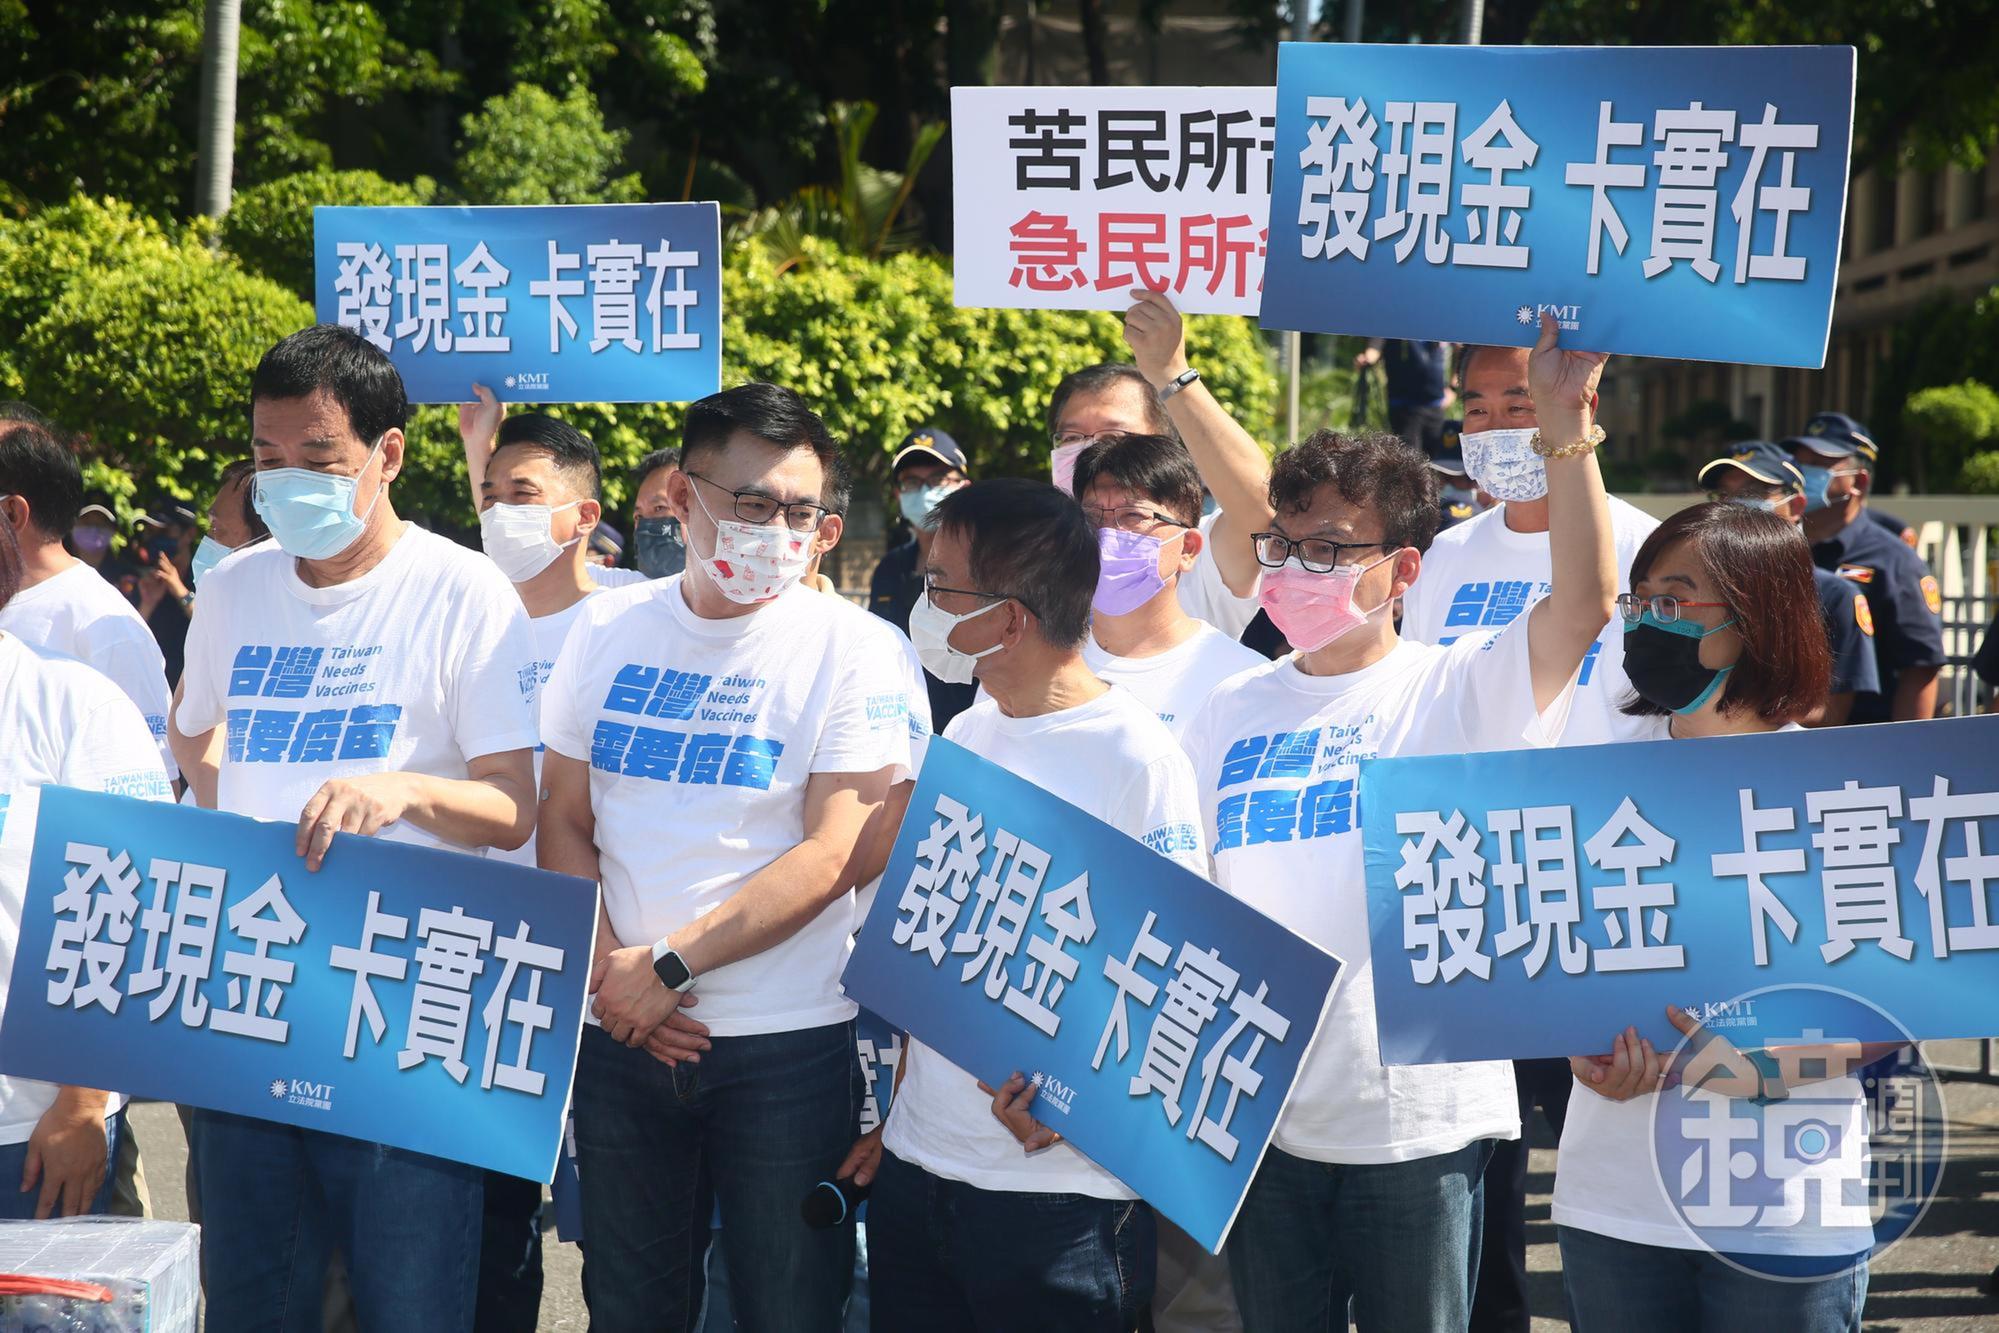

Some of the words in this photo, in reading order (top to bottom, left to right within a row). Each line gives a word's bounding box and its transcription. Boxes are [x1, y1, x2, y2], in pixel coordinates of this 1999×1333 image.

[1298, 96, 1539, 269] 發現金
[1565, 101, 1819, 284] 卡實在
[1008, 210, 1268, 297] 急民所
[335, 240, 511, 353] 發現金
[529, 239, 701, 354] 卡實在
[1537, 303, 1581, 320] KMT
[518, 373, 550, 383] KMT
[1445, 581, 1533, 628] 台灣
[227, 645, 325, 698] 台灣
[322, 663, 366, 679] Needs
[330, 644, 384, 660] Taiwan
[315, 680, 376, 698] Vaccines
[603, 663, 713, 721] 台灣
[706, 691, 750, 705] Needs
[701, 708, 757, 724] Vaccines
[591, 719, 785, 791] 需要疫苗
[1217, 727, 1322, 791] 台灣
[1141, 825, 1175, 844] TAIWA
[1213, 778, 1362, 856] 需要疫
[1394, 796, 1685, 985] 發現金
[1711, 774, 1999, 967] 卡實在
[45, 842, 308, 1043] 發現金
[329, 890, 566, 1096] 卡實在
[893, 792, 1097, 1038] 發現金
[1090, 910, 1291, 1162] 卡實在
[1704, 1000, 1756, 1017] KMT
[290, 1079, 336, 1100] KMT
[1045, 1075, 1078, 1104] KMT
